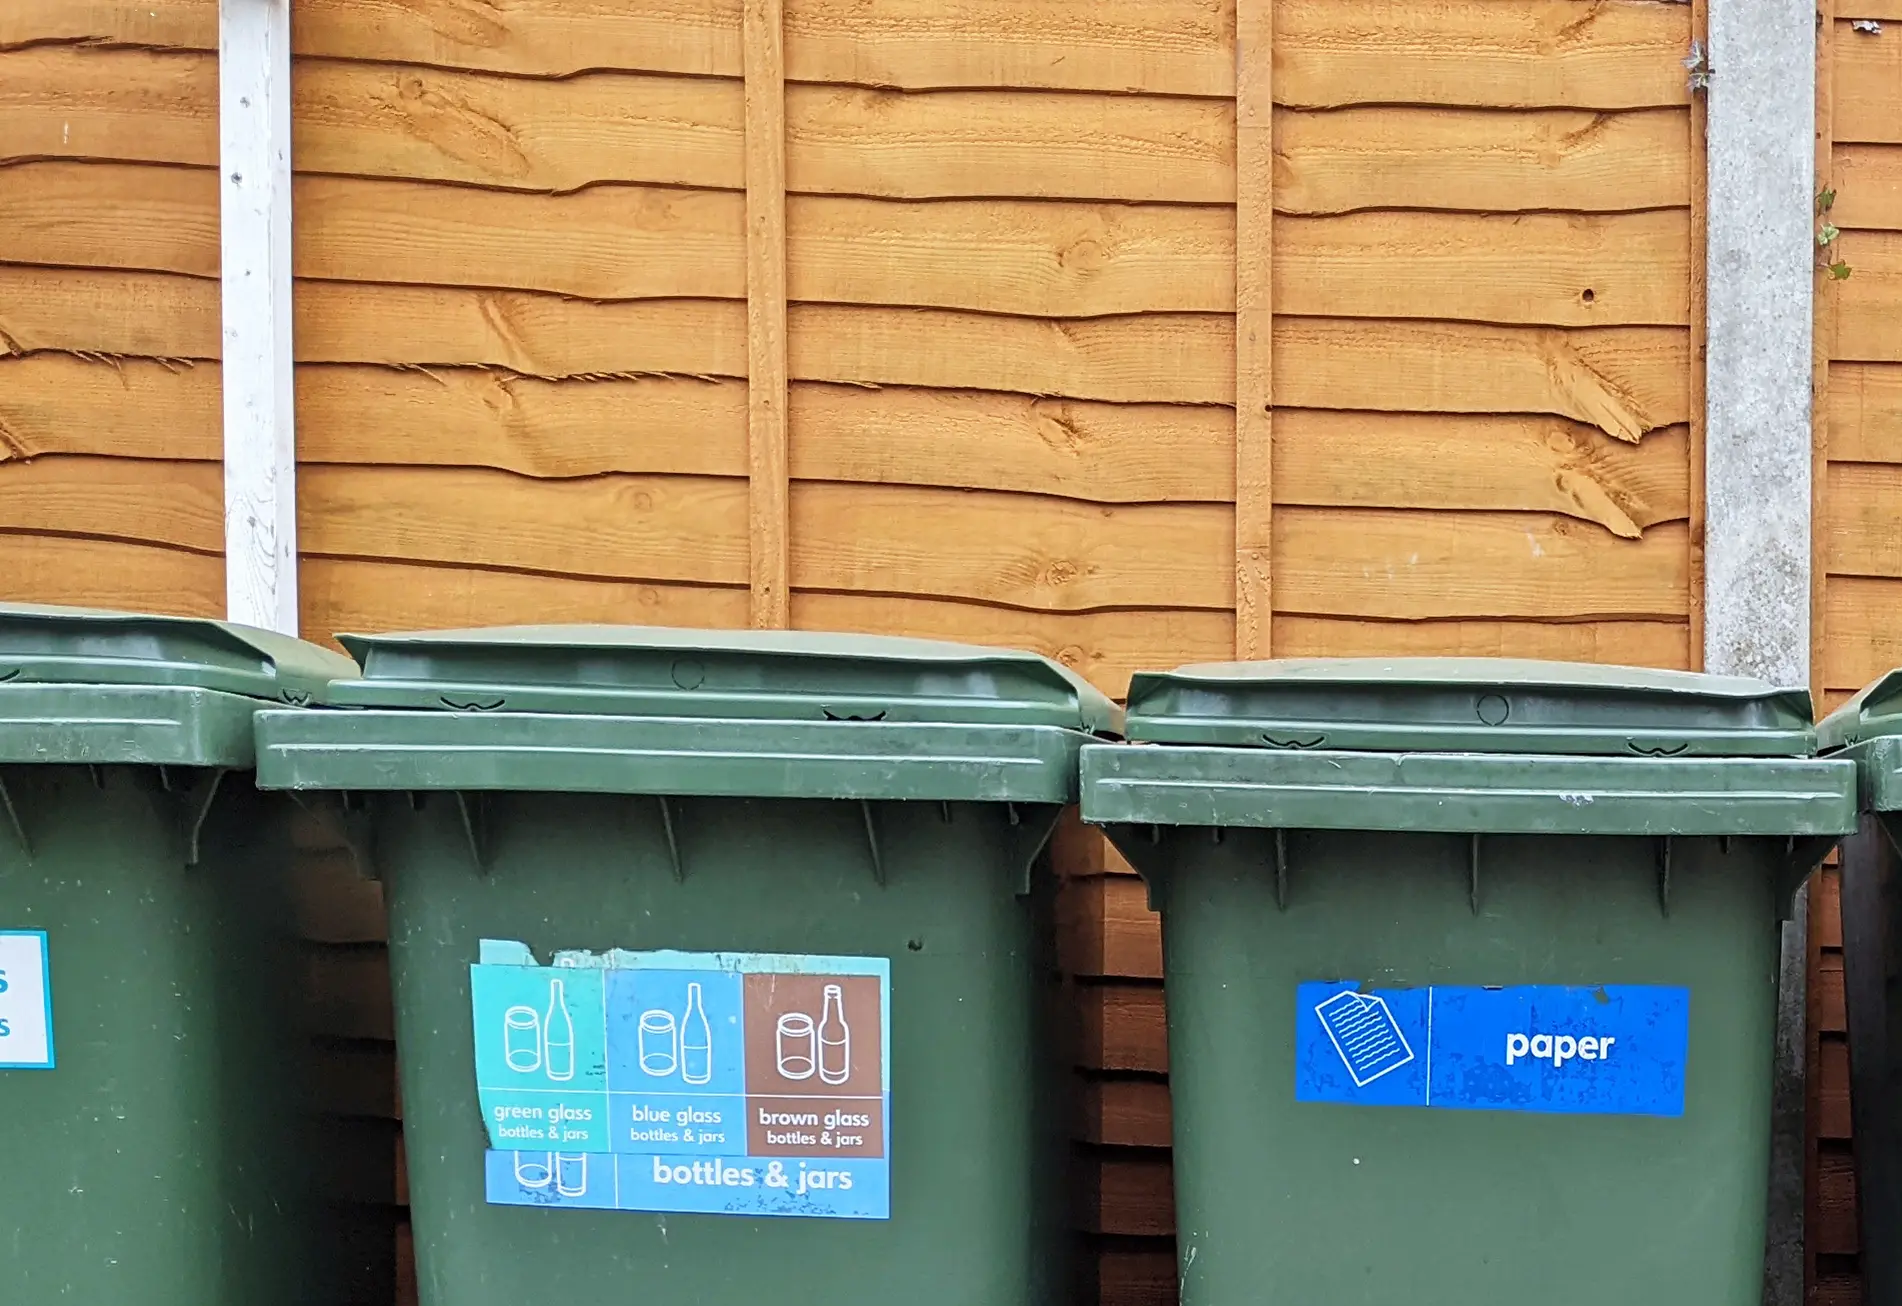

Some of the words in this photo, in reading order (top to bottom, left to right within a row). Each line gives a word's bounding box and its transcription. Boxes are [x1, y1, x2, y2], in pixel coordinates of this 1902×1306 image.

[1506, 1032, 1616, 1068] paper
[494, 1106, 543, 1122] green
[548, 1104, 593, 1123] glass
[632, 1104, 671, 1122] blue
[676, 1105, 722, 1127] glass
[759, 1108, 819, 1126] brown
[824, 1109, 870, 1130] glass
[498, 1124, 545, 1139] bottles
[548, 1125, 560, 1139] &
[562, 1125, 589, 1143] jars
[630, 1127, 679, 1141] bottles
[683, 1128, 695, 1142] &
[698, 1128, 726, 1145] jars
[767, 1130, 817, 1145] bottles
[820, 1131, 833, 1146] &
[835, 1132, 863, 1148] jars
[653, 1155, 755, 1188] bottles
[764, 1160, 790, 1188] &
[796, 1161, 853, 1195] jars
